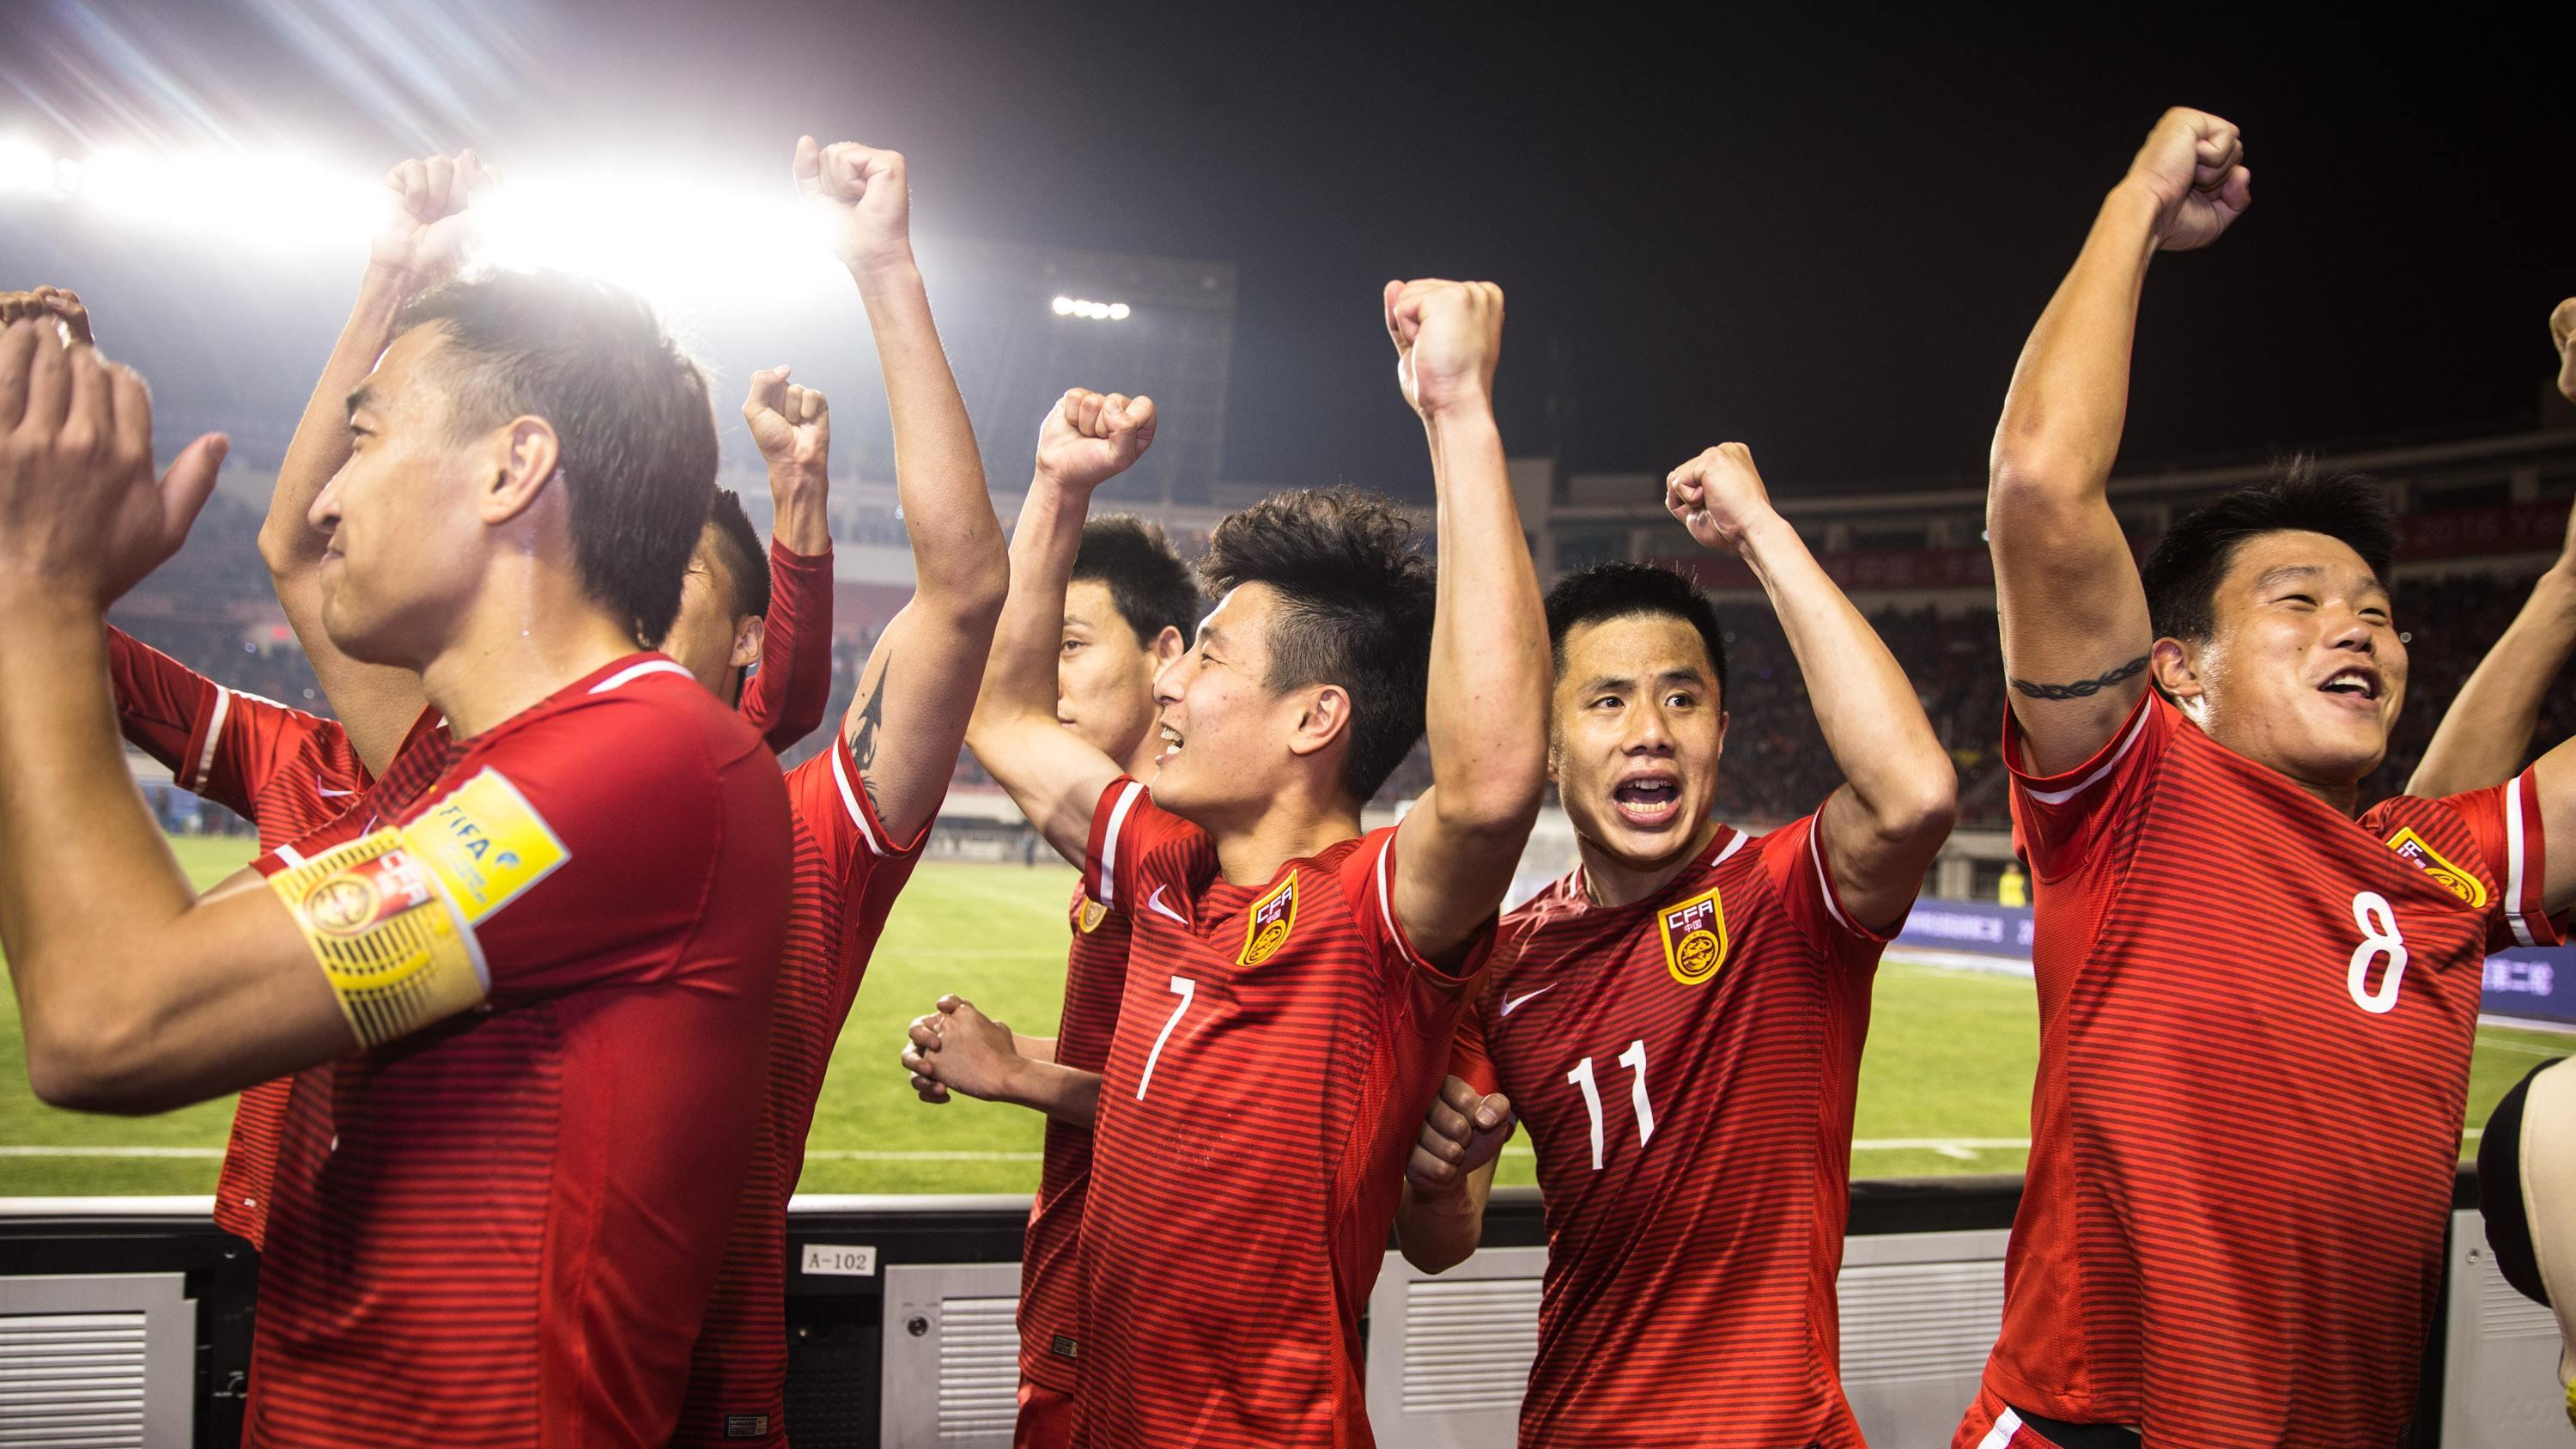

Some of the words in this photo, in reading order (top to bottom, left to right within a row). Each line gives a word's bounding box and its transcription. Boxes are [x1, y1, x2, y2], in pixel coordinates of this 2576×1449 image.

[440, 806, 489, 860] FIFA
[1256, 885, 1292, 924] CFA
[1668, 899, 1713, 929] CFA
[2347, 891, 2409, 1014] 8
[1136, 975, 1196, 1101] 7
[1567, 1039, 1655, 1170] 11
[809, 1252, 867, 1270] A-102
